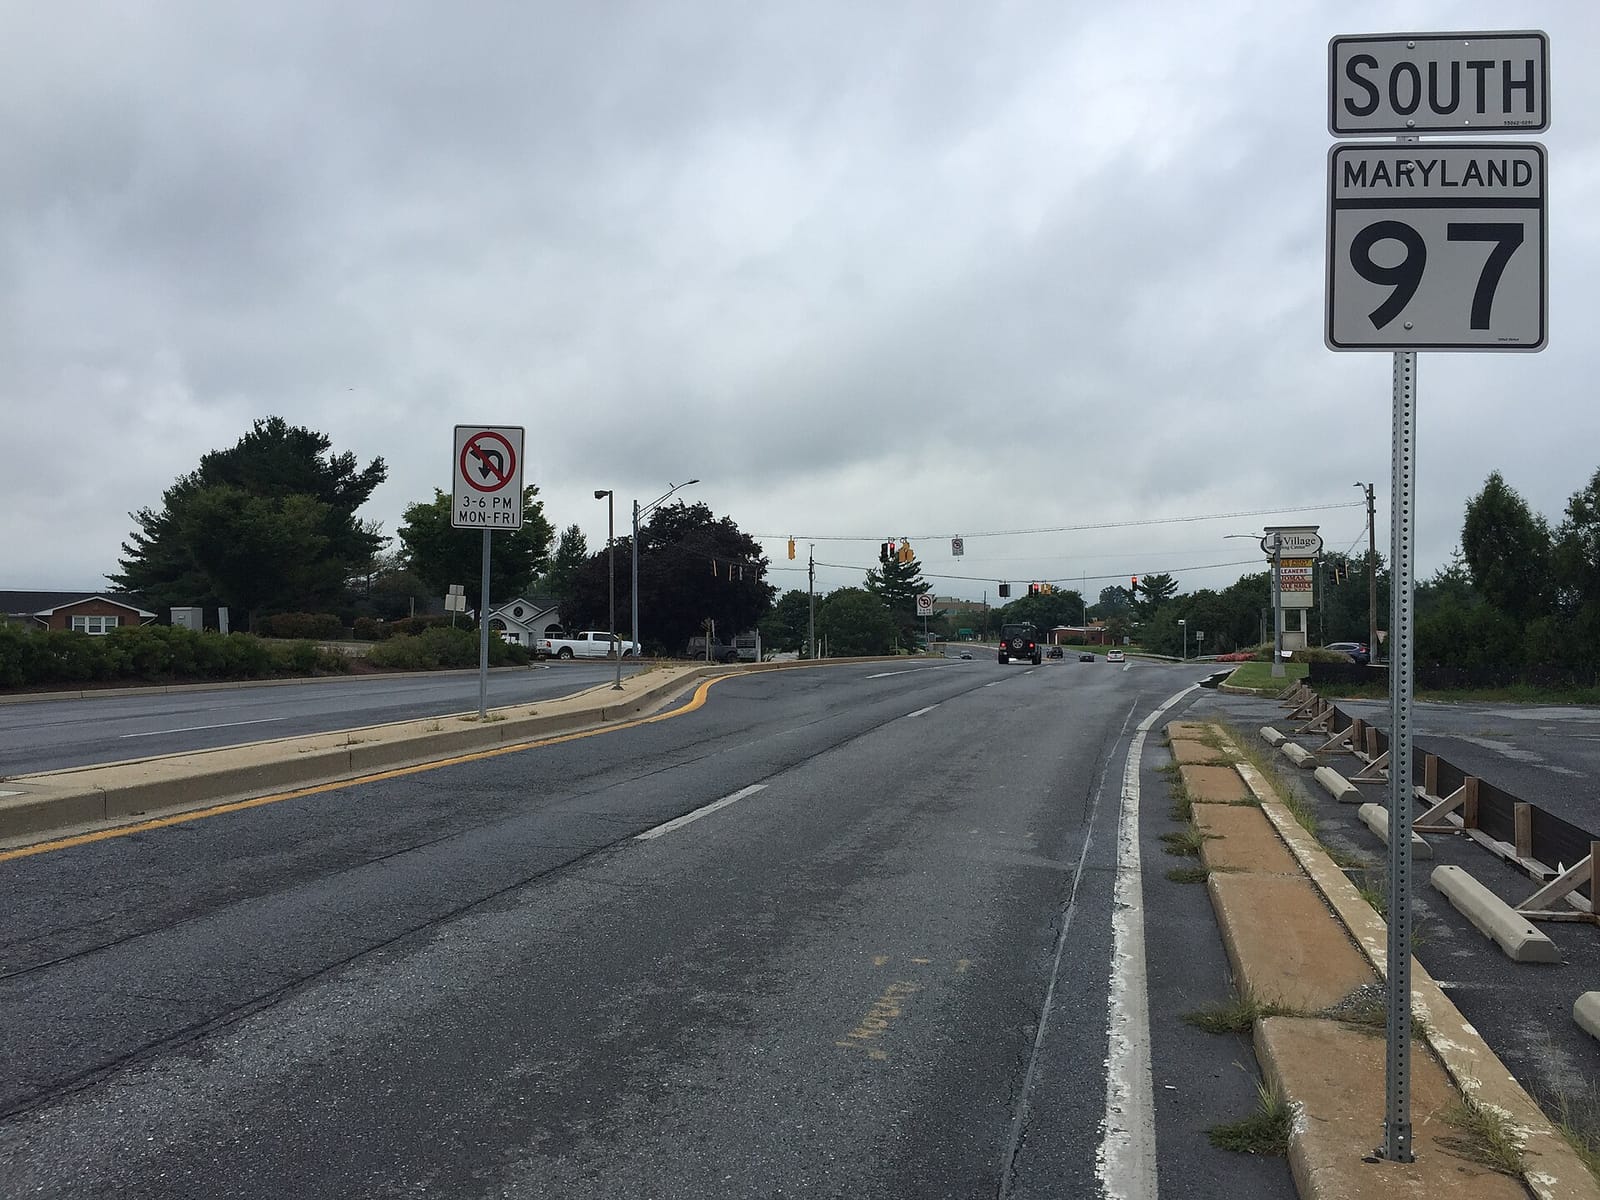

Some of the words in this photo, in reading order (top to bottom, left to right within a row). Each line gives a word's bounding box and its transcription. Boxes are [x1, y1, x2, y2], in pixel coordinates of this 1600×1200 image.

[1344, 53, 1535, 117] SOUTH
[1344, 159, 1533, 188] MARYLAND
[1350, 220, 1524, 331] 97
[463, 495, 486, 508] 3-6
[493, 497, 512, 509] PM
[459, 510, 515, 524] MON-FRI
[1283, 536, 1316, 546] Village
